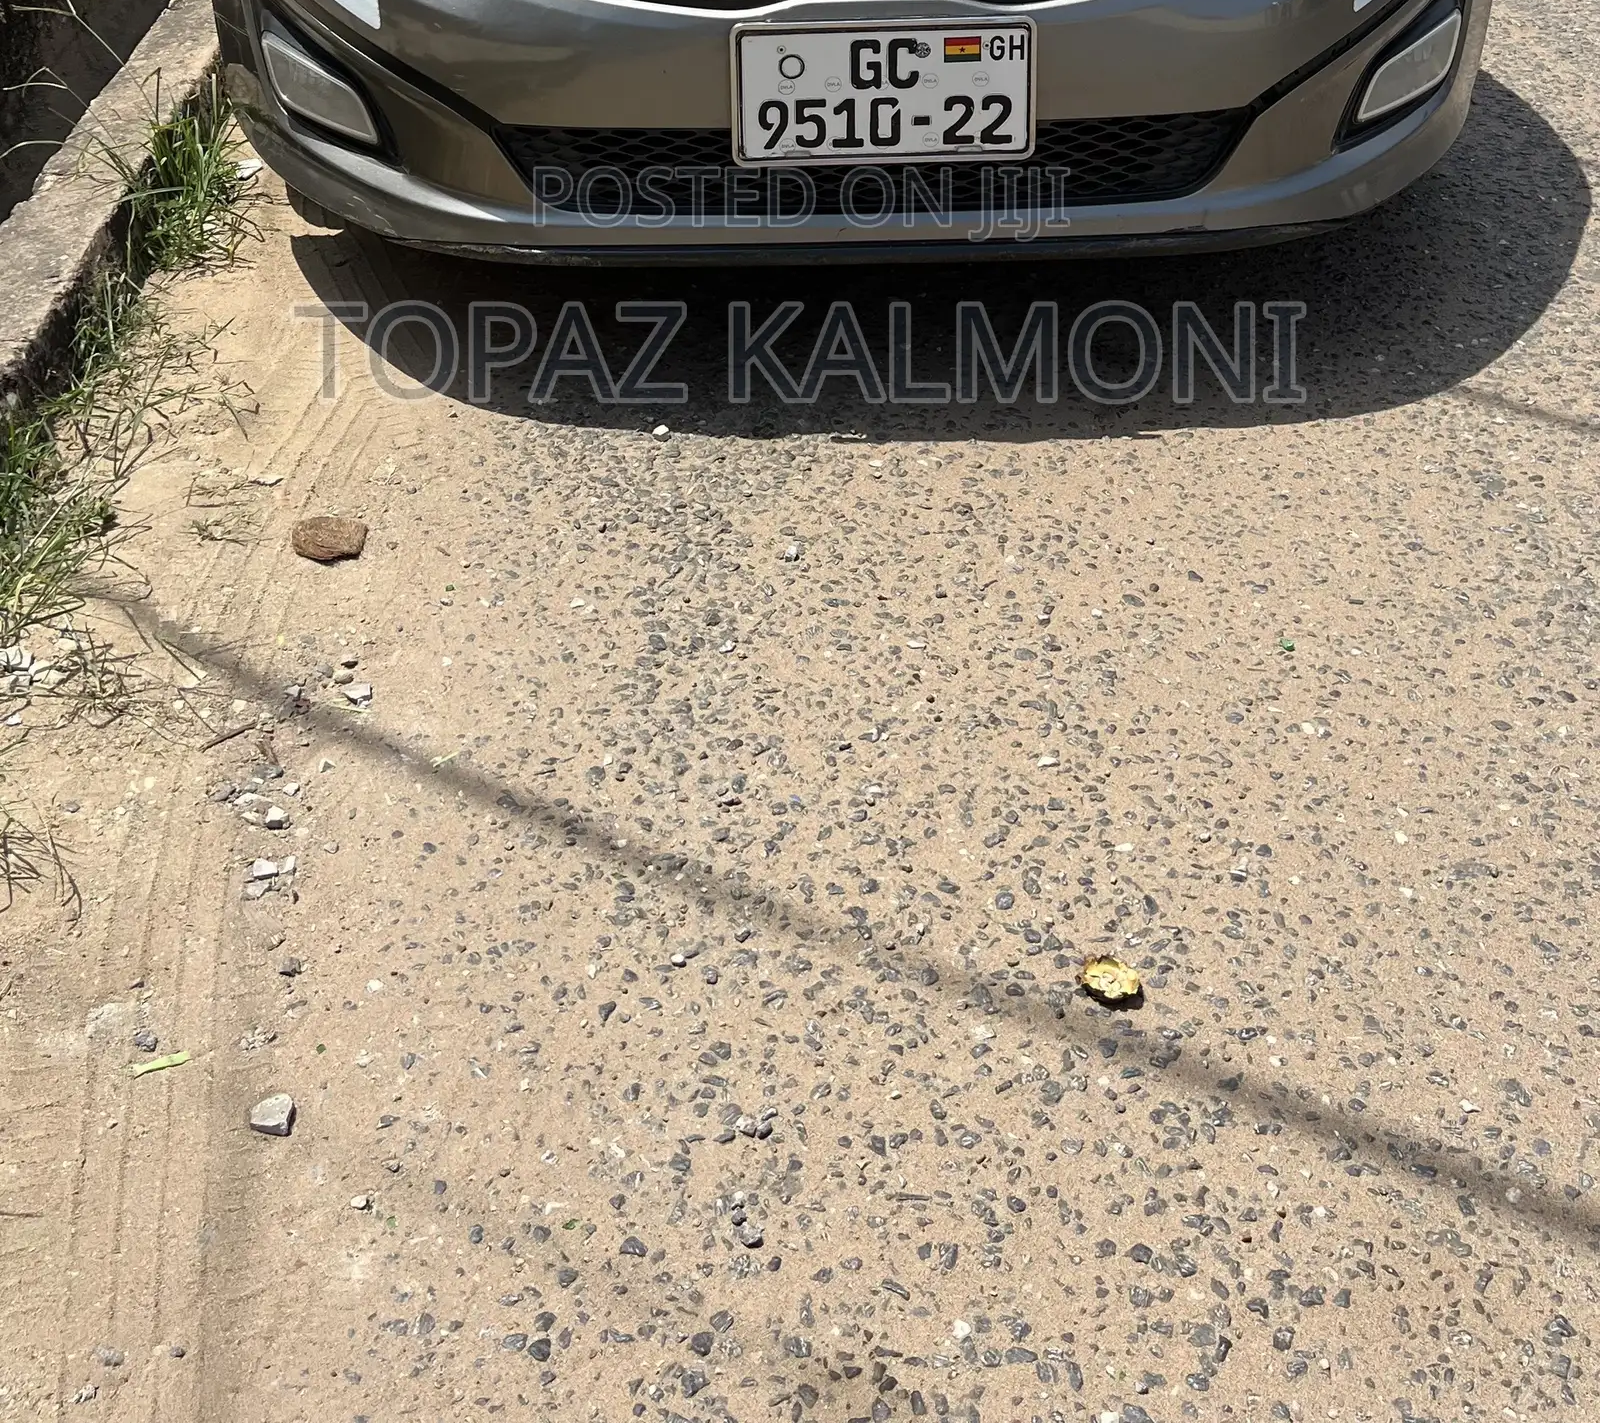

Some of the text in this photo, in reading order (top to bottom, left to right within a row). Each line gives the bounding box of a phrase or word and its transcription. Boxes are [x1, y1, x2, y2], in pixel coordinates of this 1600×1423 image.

[850, 38, 919, 90] GC
[989, 34, 1025, 61] GH
[757, 94, 1013, 150] 9510-22
